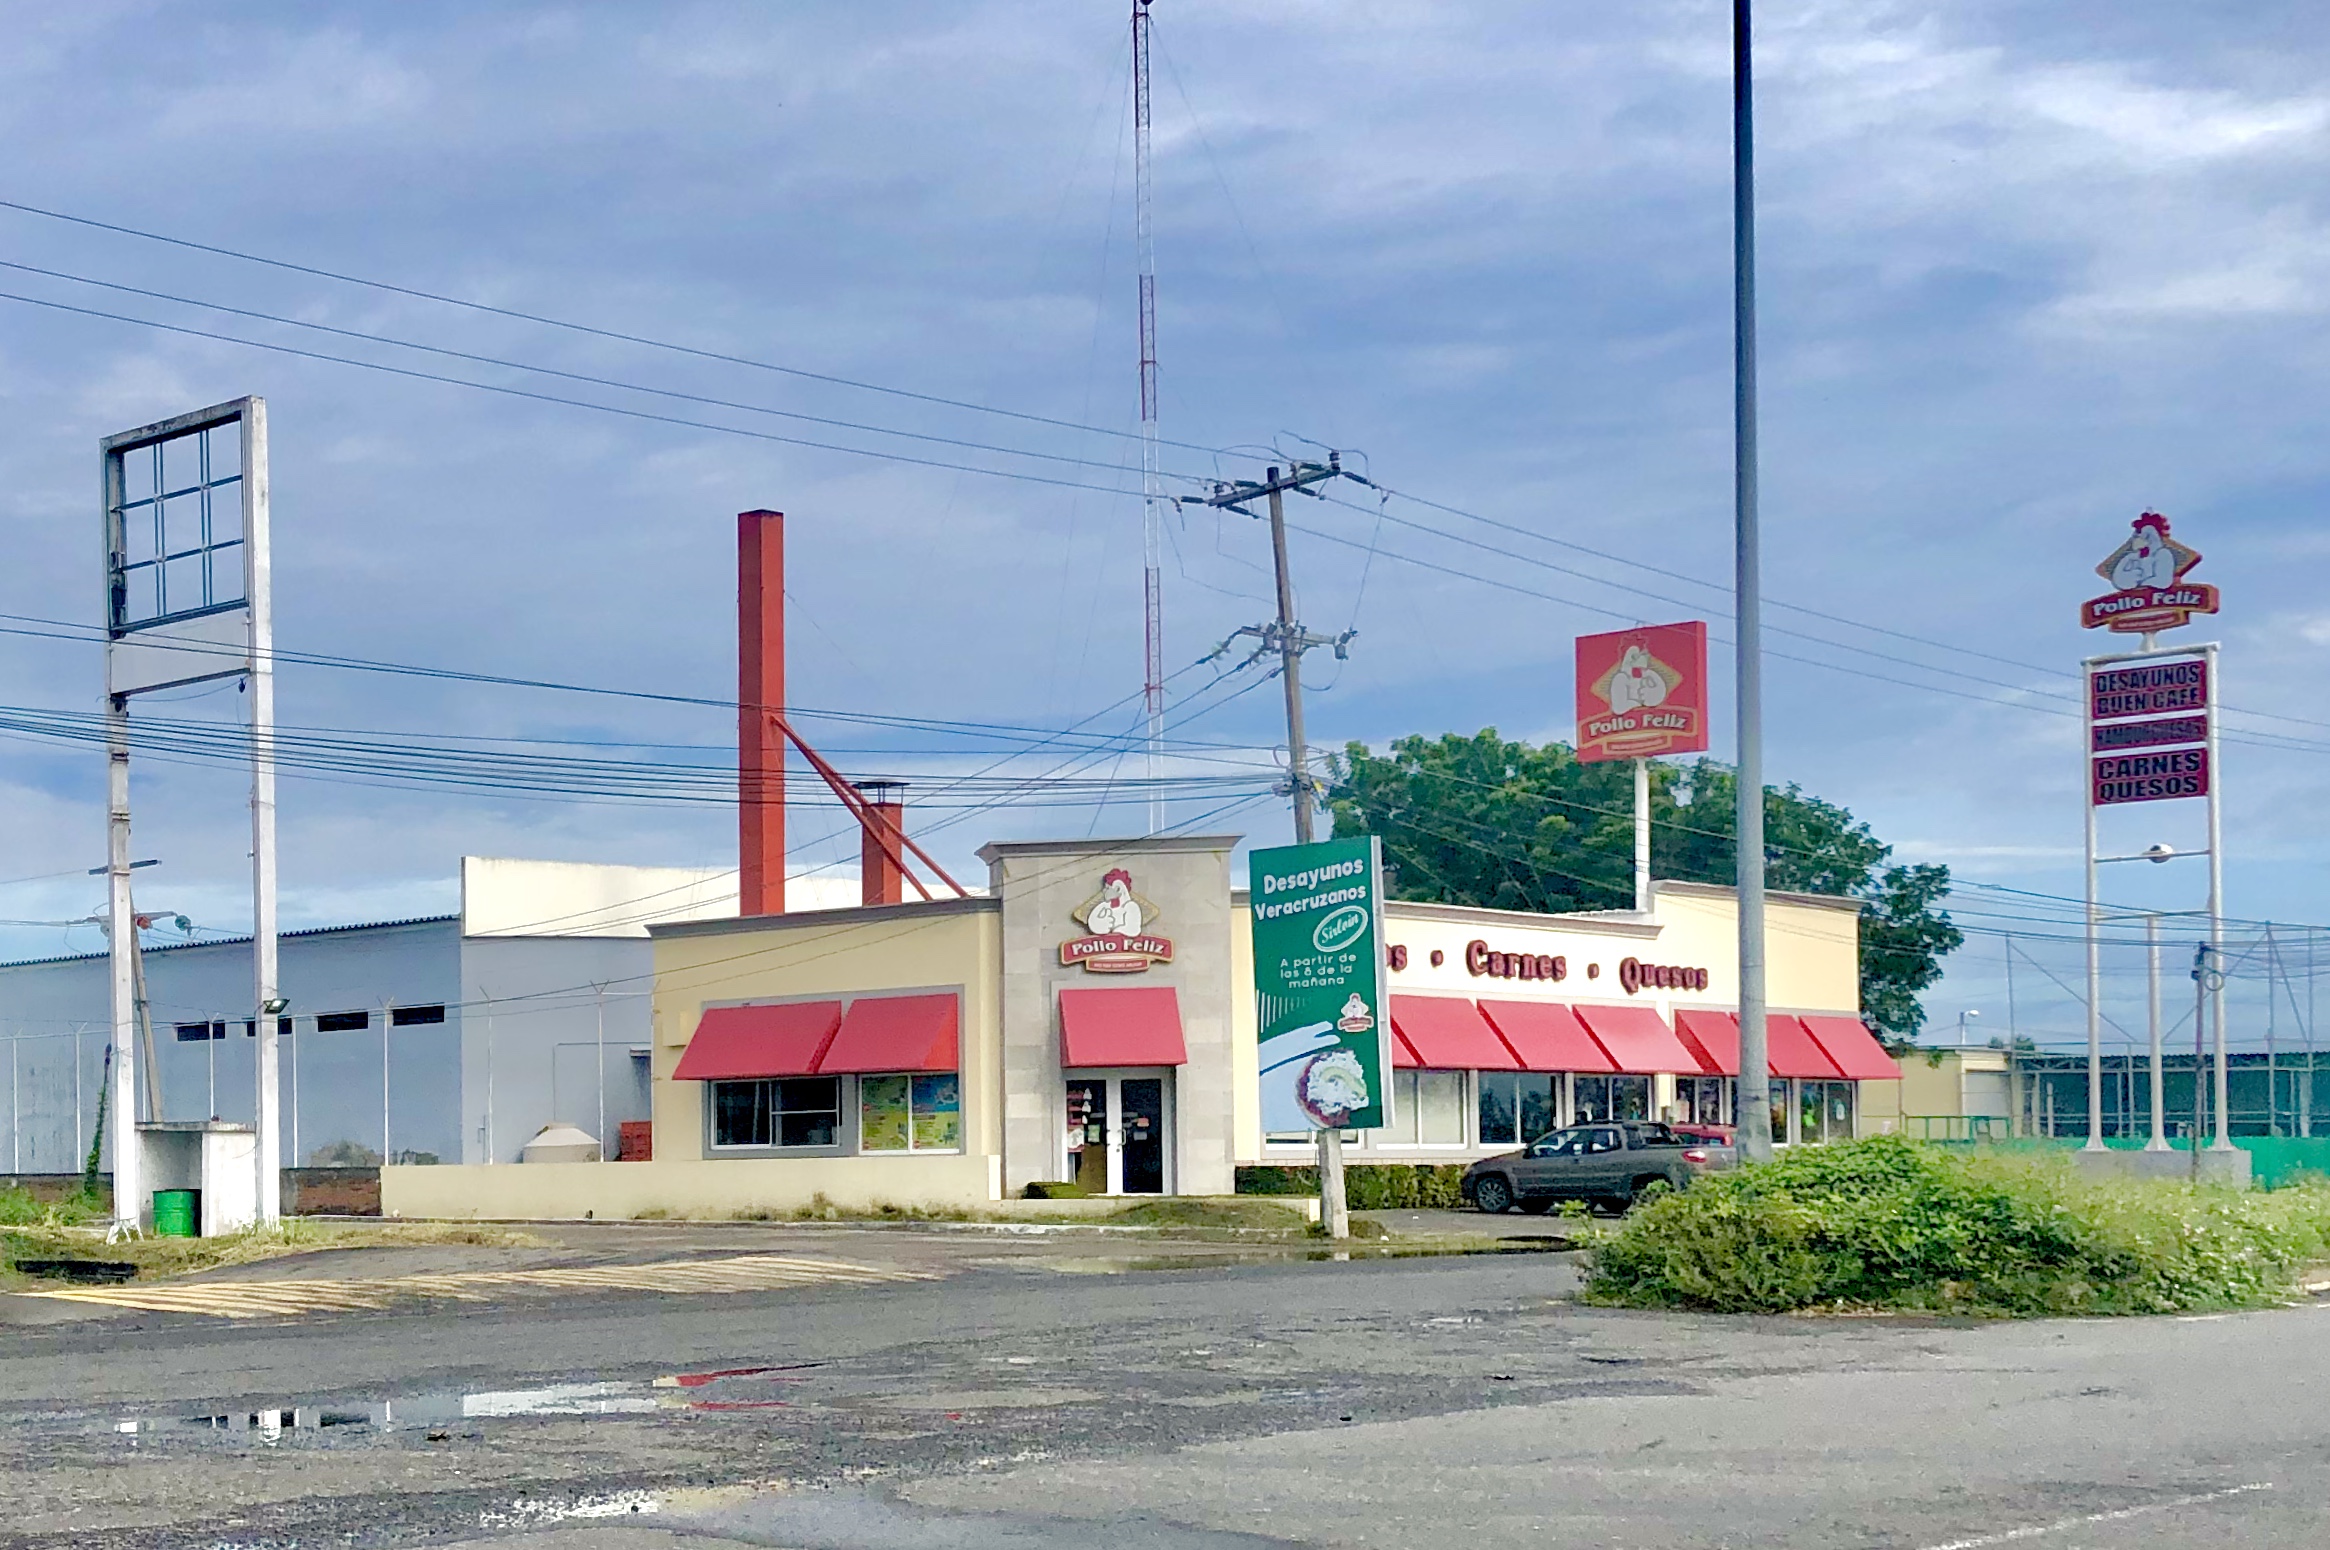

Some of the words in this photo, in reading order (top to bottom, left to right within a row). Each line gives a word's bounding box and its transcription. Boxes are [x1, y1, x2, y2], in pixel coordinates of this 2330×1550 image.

[2093, 597, 2145, 616] Pollo
[2151, 591, 2201, 605] Feliz
[2096, 664, 2200, 693] DESAYUNOS
[2097, 693, 2146, 714] BUEN
[1589, 718, 1636, 737] Pollo
[1642, 713, 1687, 729] Feliz
[2098, 752, 2200, 780] CARNES
[2100, 776, 2199, 801] QUESOS
[1263, 858, 1364, 895] Desayunos
[1254, 885, 1367, 921] Veracruzanos
[1321, 913, 1359, 944] Sirloin
[1071, 940, 1117, 956] Pollo
[1123, 939, 1165, 954] Feliz
[1280, 958, 1288, 968] A
[1293, 954, 1333, 969] partir
[1338, 953, 1357, 963] de
[1280, 968, 1300, 979] las
[1317, 965, 1335, 976] de
[1340, 963, 1353, 974] la
[1466, 939, 1567, 982] Carnes
[1619, 956, 1709, 995] Quesos
[1288, 976, 1345, 989] mañana
